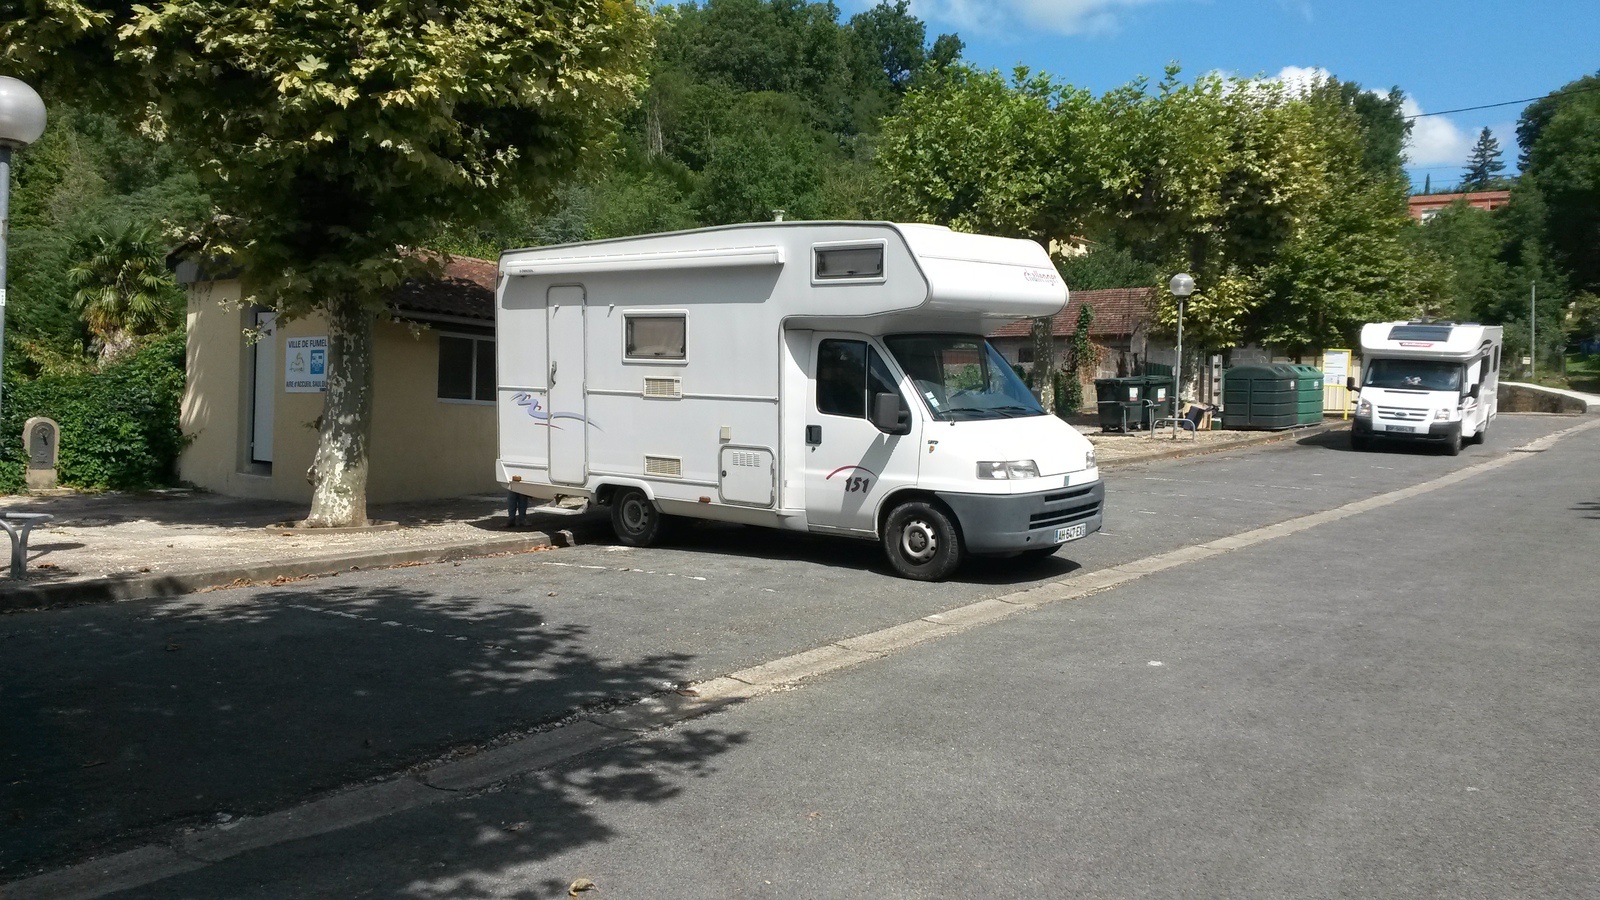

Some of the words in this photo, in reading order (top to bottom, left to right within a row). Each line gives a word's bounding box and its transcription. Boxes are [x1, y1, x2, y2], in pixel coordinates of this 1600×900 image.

[288, 340, 301, 348] VILLE
[302, 340, 309, 348] DE
[310, 339, 327, 348] FUMEL
[845, 477, 870, 493] 151
